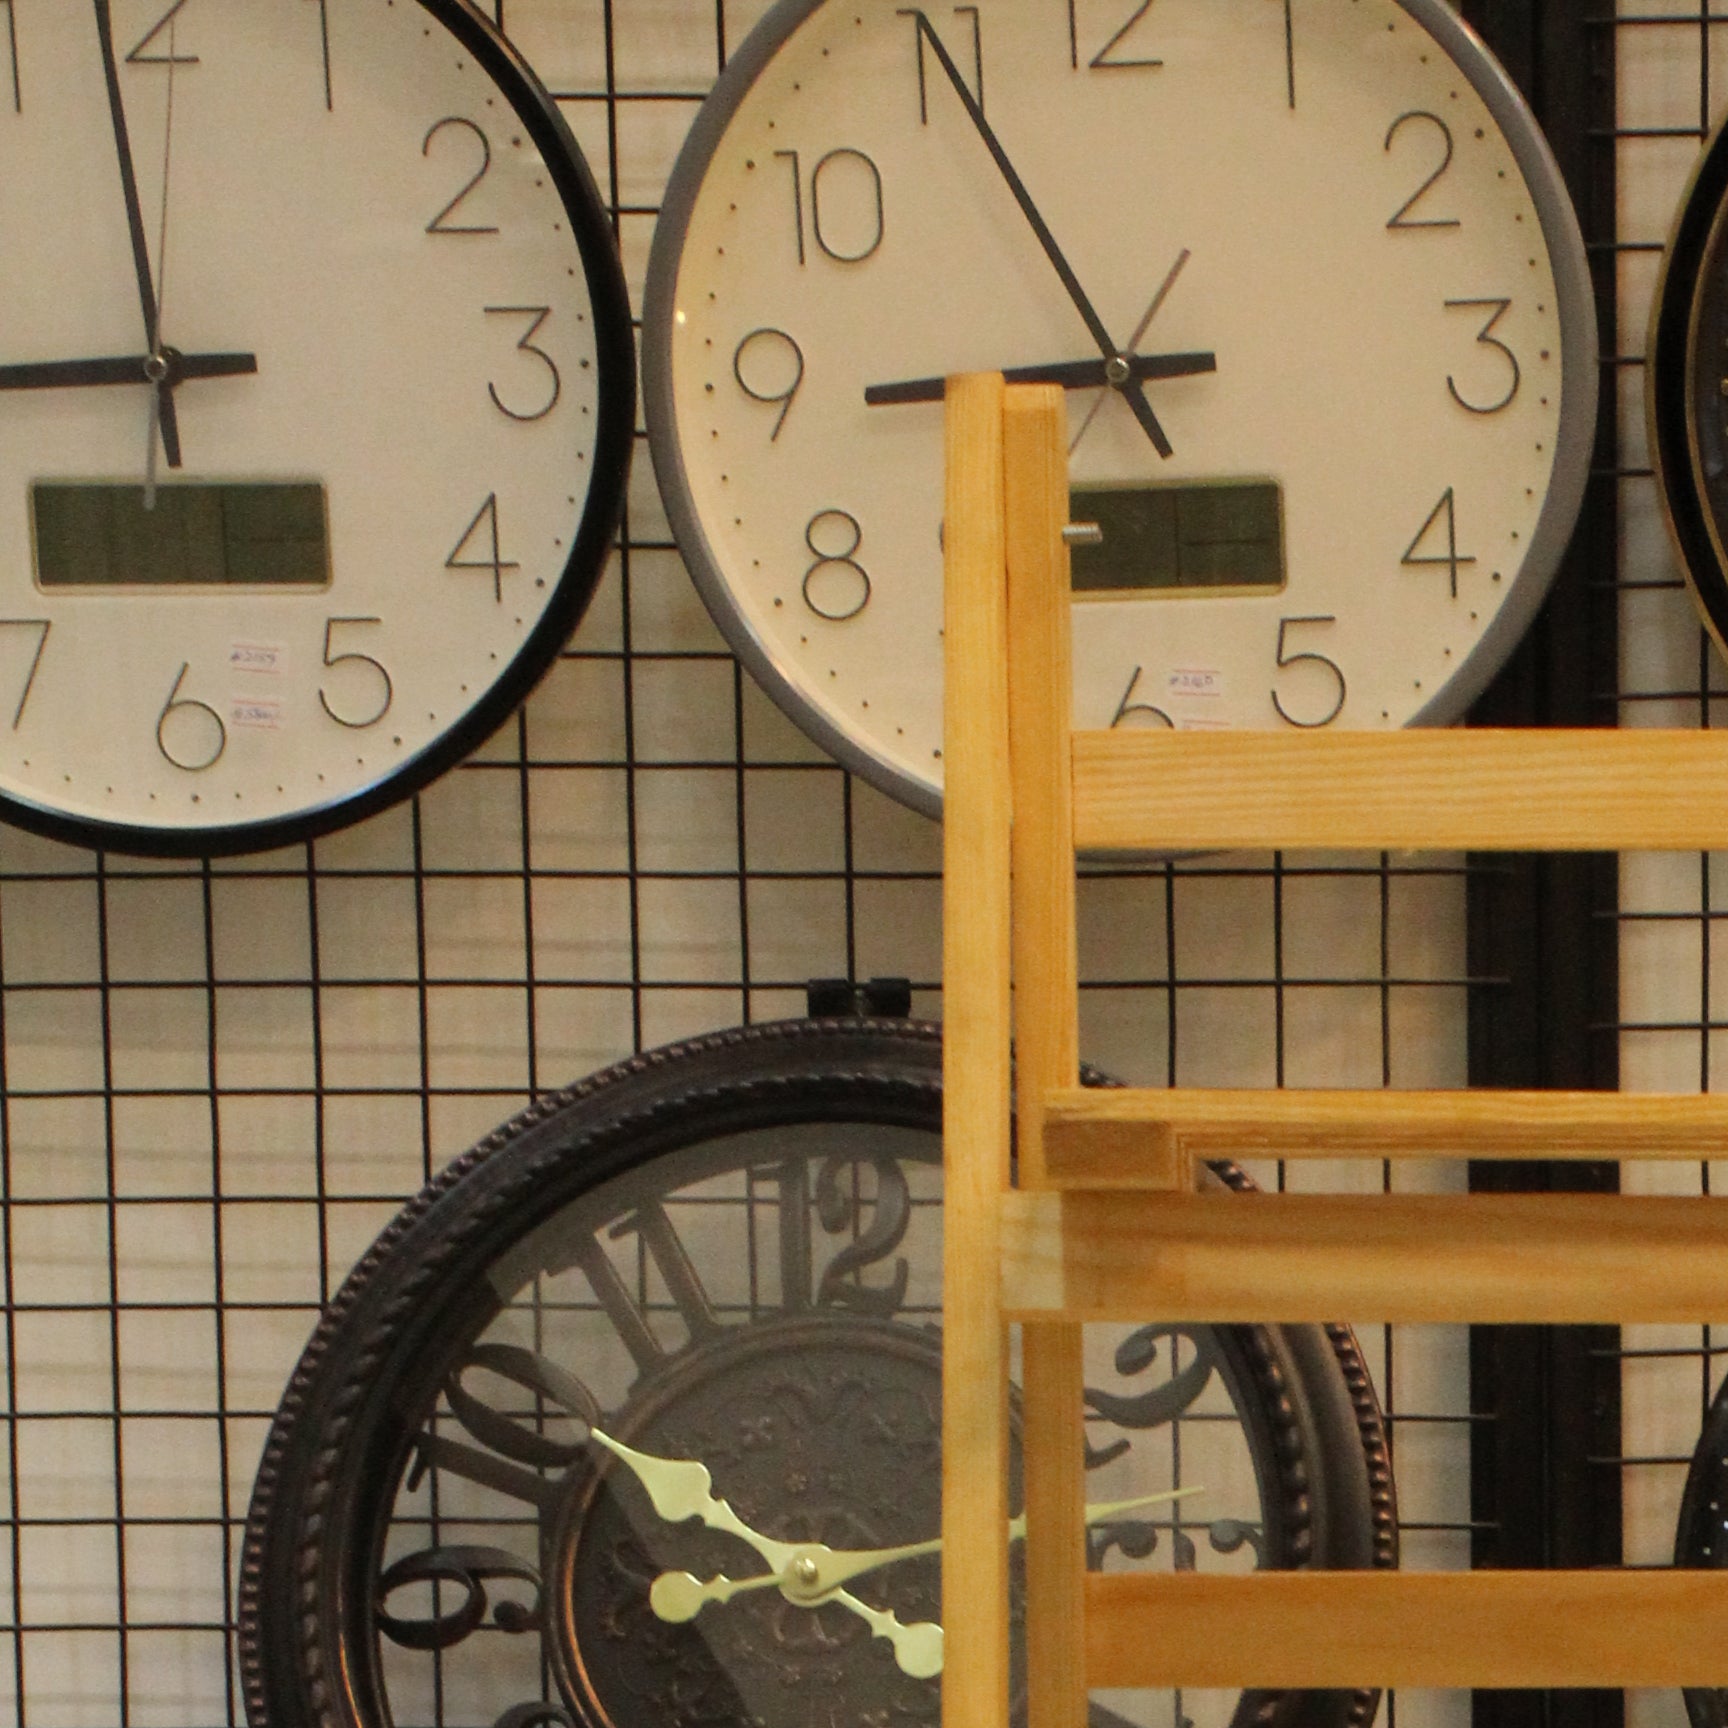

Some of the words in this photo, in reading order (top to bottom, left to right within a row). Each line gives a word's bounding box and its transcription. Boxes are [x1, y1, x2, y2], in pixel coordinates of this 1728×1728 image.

[895, 6, 985, 125] 11
[422, 117, 500, 235] 2
[775, 148, 884, 265] 10
[1385, 111, 1460, 229] 2
[484, 306, 561, 421] 3
[733, 328, 805, 442] 9
[1444, 299, 1520, 414] 3
[445, 492, 521, 603] 4
[802, 509, 872, 620] 8
[1400, 487, 1477, 600] 4
[0, 620, 52, 731] 7
[157, 662, 226, 771] 6
[317, 616, 392, 728] 5
[1270, 616, 1346, 728] 5
[747, 1155, 911, 1315] 12
[545, 1200, 722, 1390] 11
[400, 1343, 602, 1505] 10
[376, 1545, 543, 1650] 9
